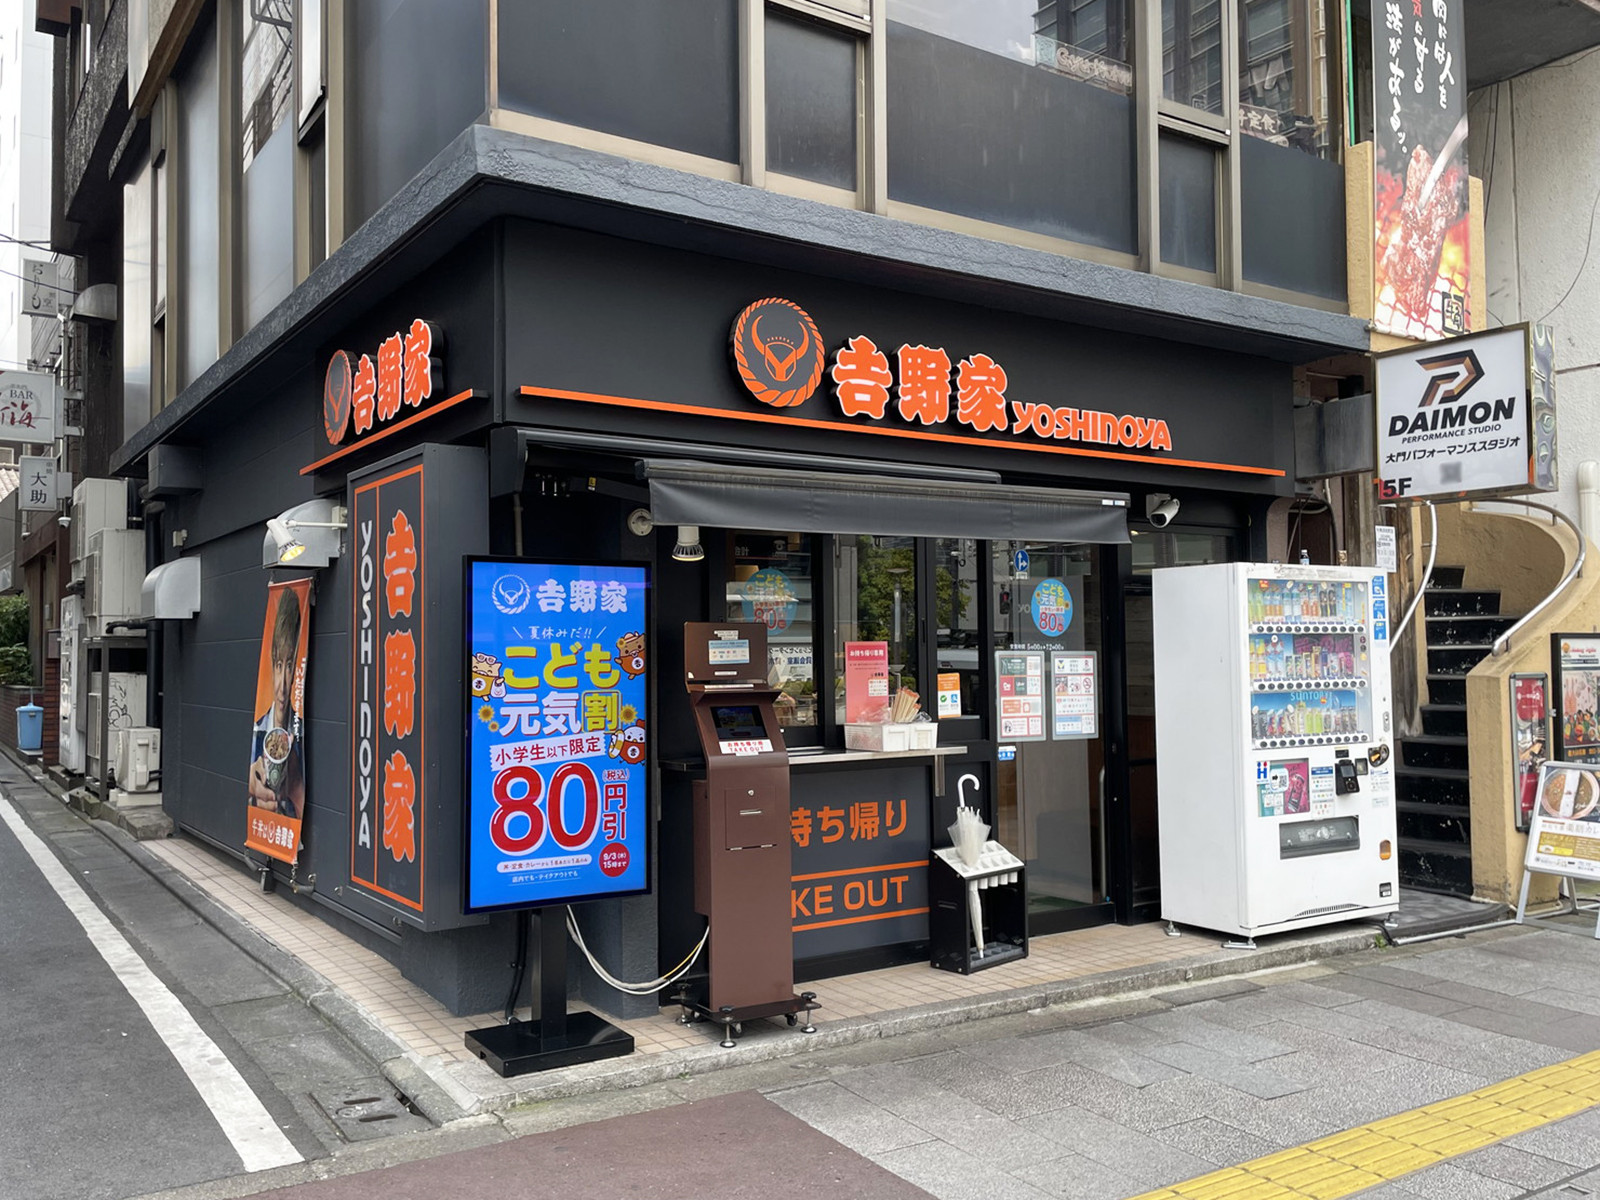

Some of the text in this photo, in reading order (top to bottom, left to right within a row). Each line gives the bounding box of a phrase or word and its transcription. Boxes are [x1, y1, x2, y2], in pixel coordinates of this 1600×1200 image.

[10, 390, 33, 400] BAR
[352, 318, 432, 435] 吉野家
[831, 334, 1008, 432] 吉野家
[1011, 400, 1174, 452] YOSHINOYA
[1388, 397, 1526, 437] DAIMON
[1401, 423, 1502, 445] PERFORMANCE STUDIO
[1385, 436, 1521, 464] 大門パフォーマンススタジオ
[30, 471, 47, 505] 大助
[1382, 477, 1412, 498] 5F
[535, 578, 628, 614] 吉野家
[1039, 611, 1057, 632] 80
[358, 520, 373, 850] YOSHINOYA
[503, 641, 621, 690] こども
[383, 508, 418, 864] 吉野家
[498, 690, 621, 738] 元気割
[495, 736, 602, 767] 小学生以下限定
[489, 761, 602, 857] 80
[602, 783, 628, 841] 円引
[844, 876, 909, 911] OUT
